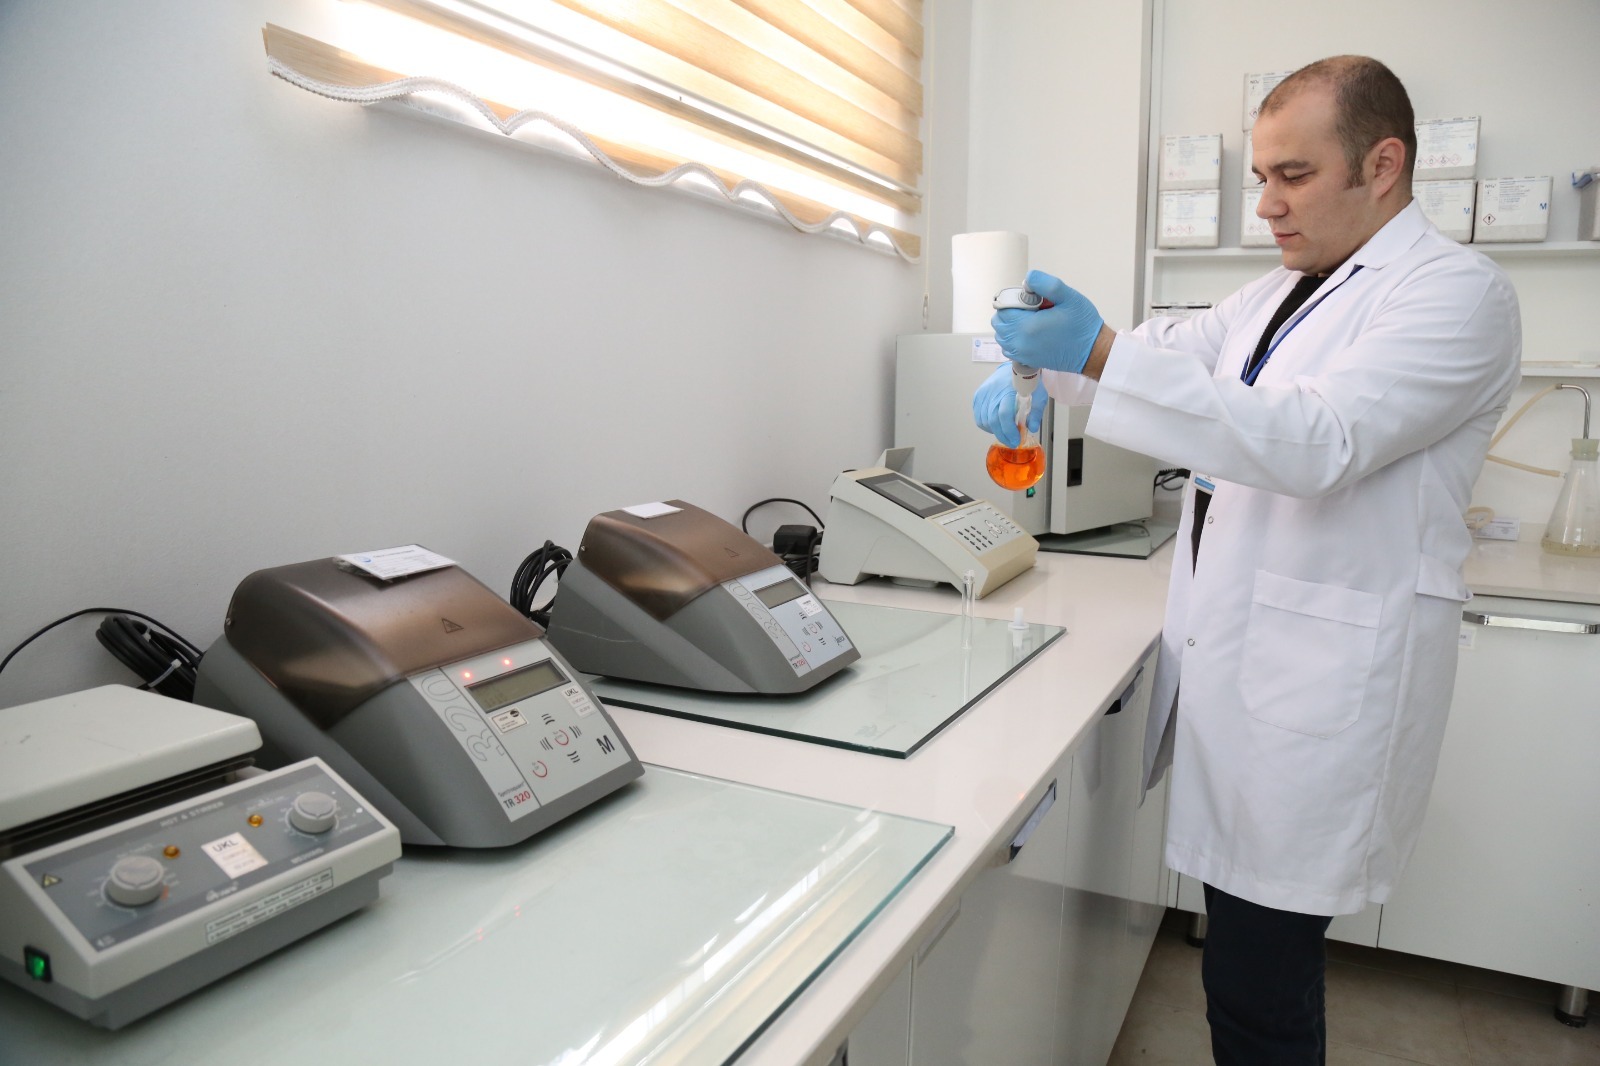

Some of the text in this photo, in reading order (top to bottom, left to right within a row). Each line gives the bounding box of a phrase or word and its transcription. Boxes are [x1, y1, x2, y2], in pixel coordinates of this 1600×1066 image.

[596, 734, 615, 755] M
[503, 790, 531, 809] TR 320
[212, 840, 239, 853] UKL
